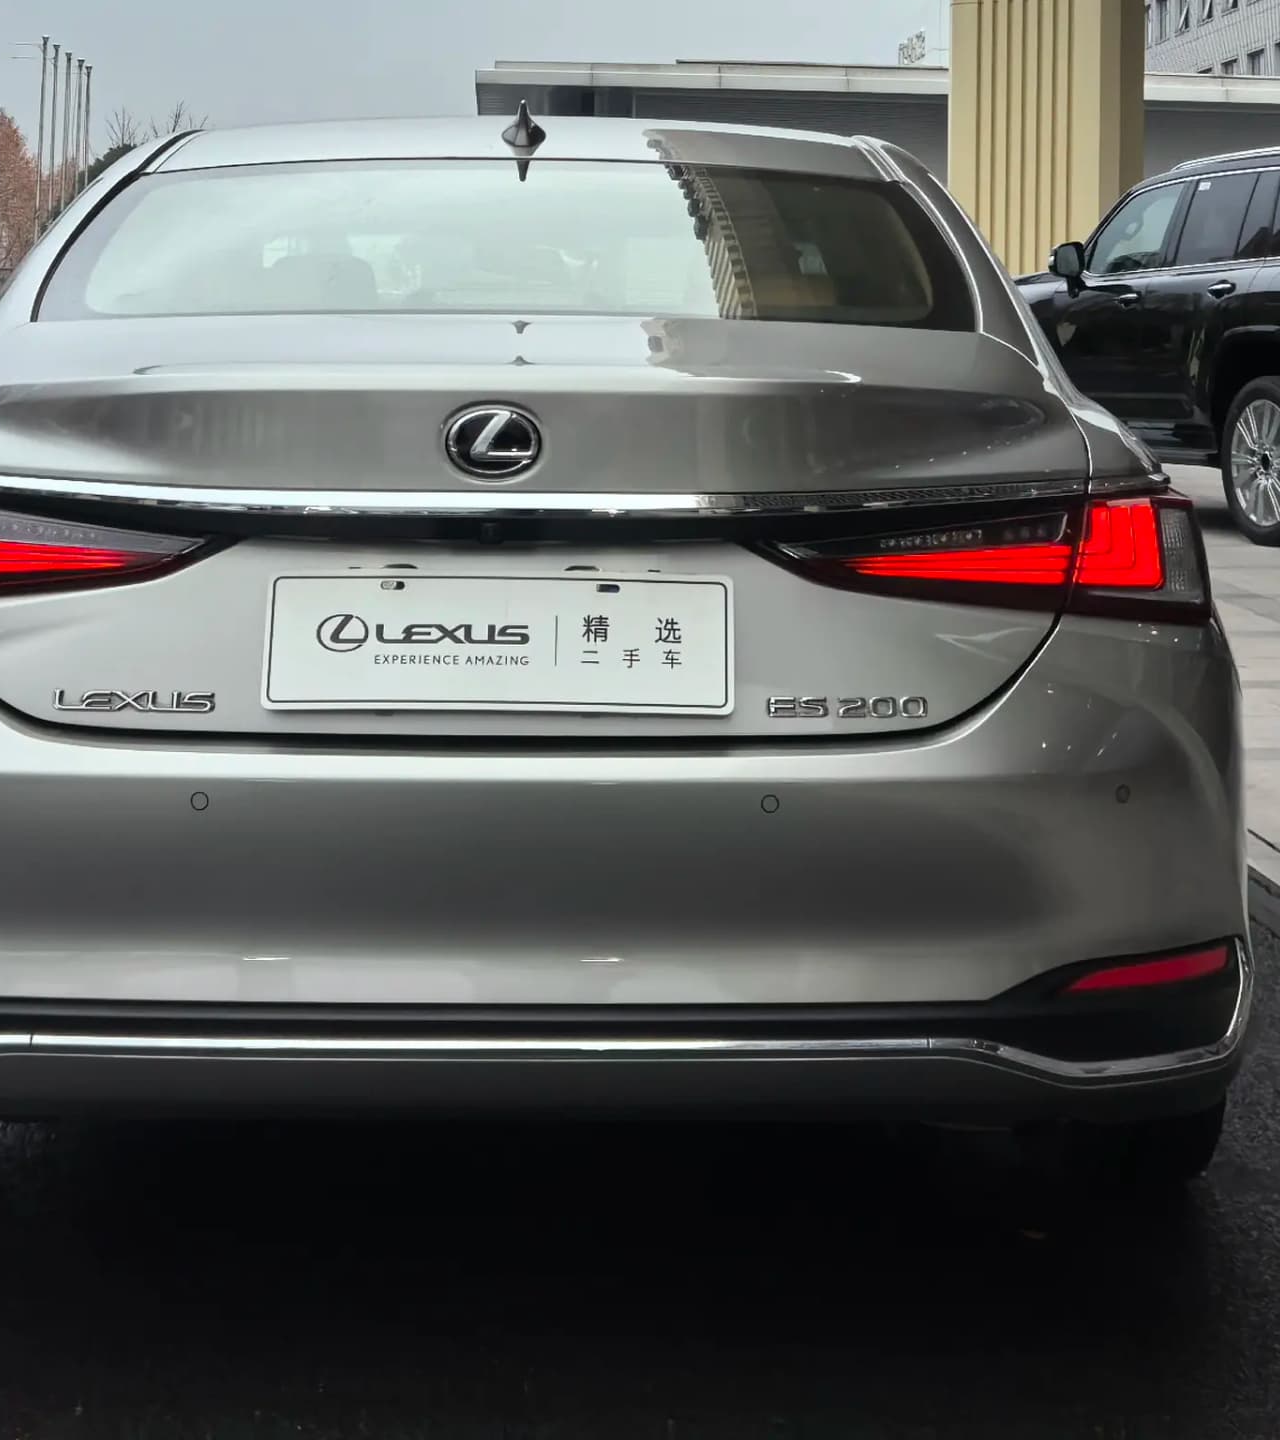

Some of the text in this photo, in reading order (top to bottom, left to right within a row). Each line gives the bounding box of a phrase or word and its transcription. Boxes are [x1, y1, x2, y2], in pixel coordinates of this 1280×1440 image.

[375, 623, 531, 646] LEXUS
[374, 654, 530, 666] EXPERIENCE AMAZING
[53, 688, 216, 714] LEXUS
[768, 696, 929, 718] ES 200
